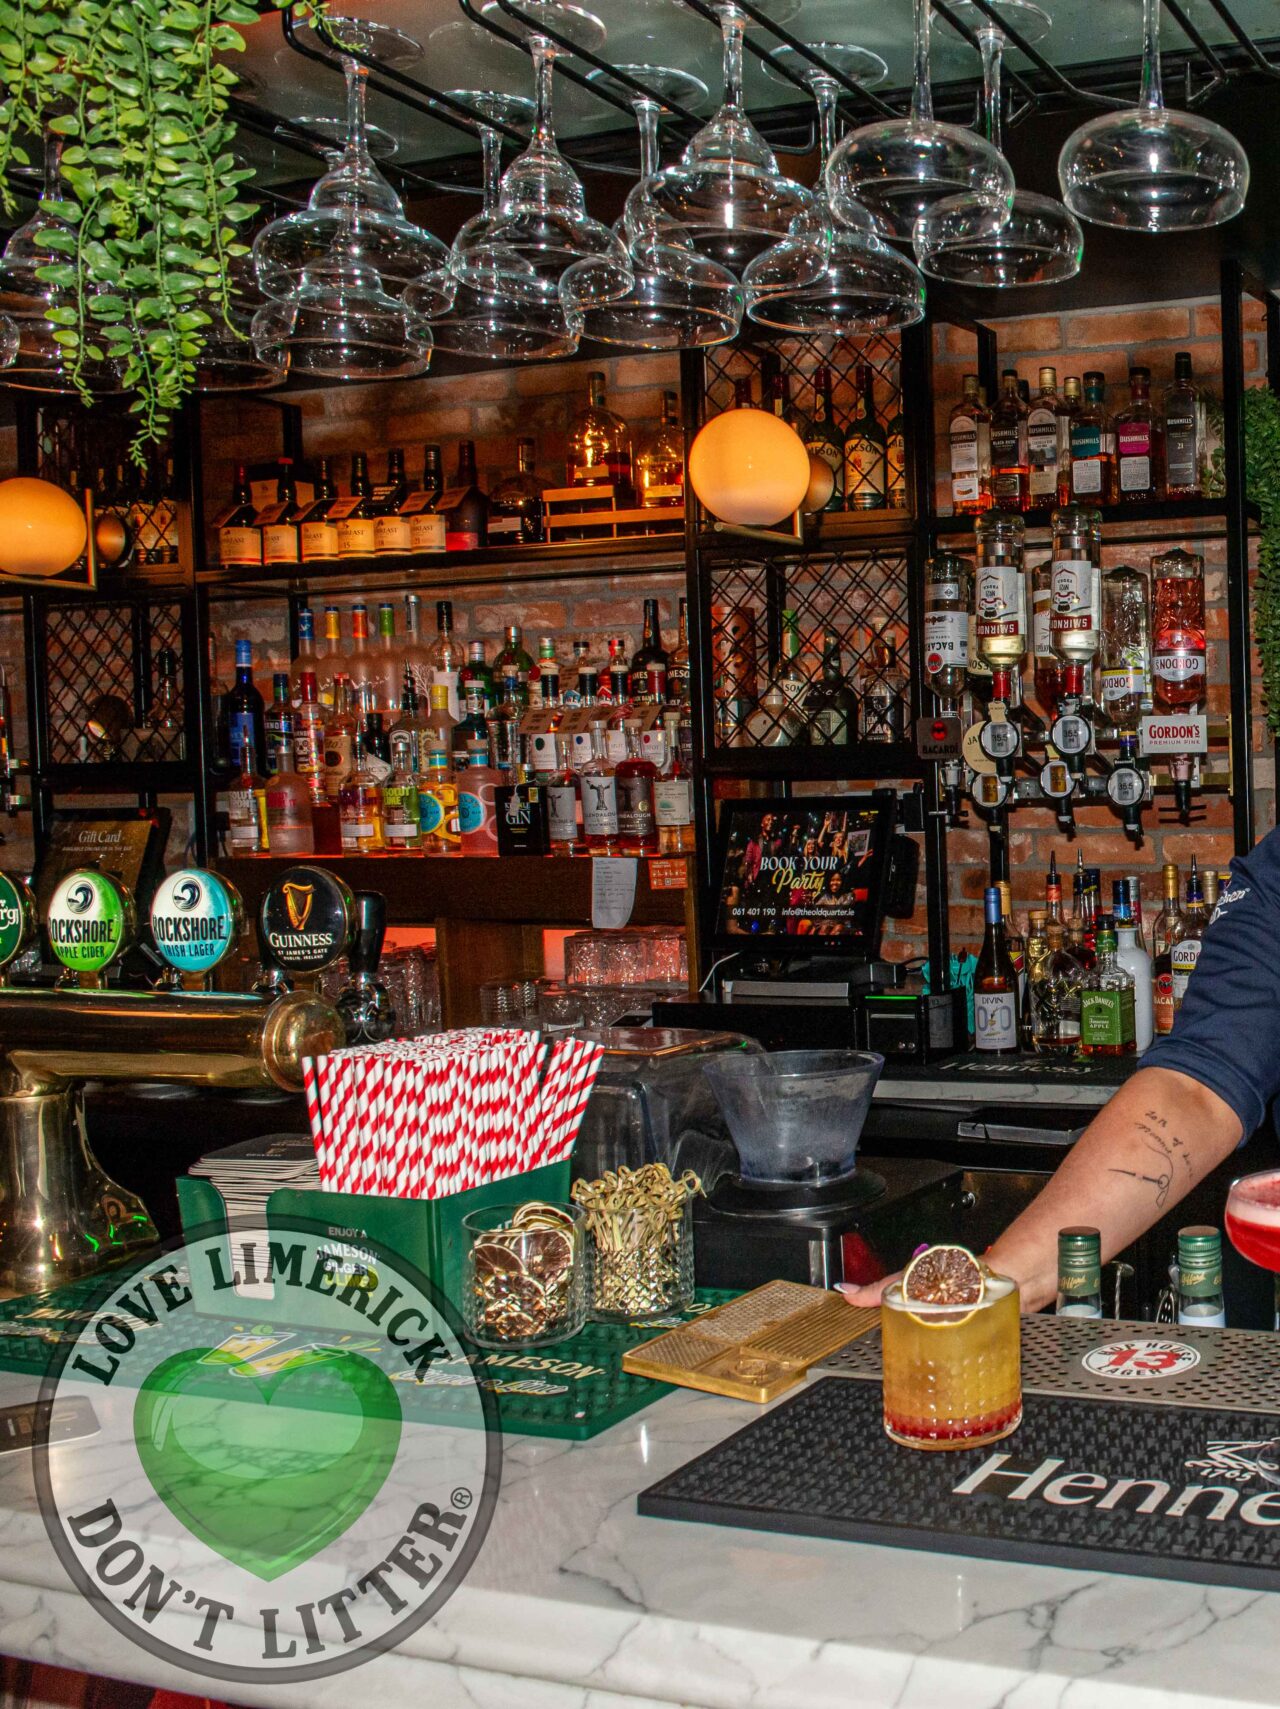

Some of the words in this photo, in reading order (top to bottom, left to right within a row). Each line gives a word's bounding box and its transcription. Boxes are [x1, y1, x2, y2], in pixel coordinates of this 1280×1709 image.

[1149, 724, 1201, 739] GORDON'S
[505, 810, 531, 825] GIN
[78, 830, 97, 843] Gift
[98, 830, 122, 843] Card
[760, 856, 799, 870] BOOK
[802, 856, 839, 871] YOUR
[772, 868, 825, 900] Party
[732, 908, 745, 916] 061
[747, 908, 760, 916] 401
[763, 908, 776, 916] 190
[781, 907, 856, 918] info@theoldquarter.ie
[49, 917, 116, 943] OCKSHORE
[269, 932, 333, 948] GUINNESS
[81, 945, 105, 959] CIDER
[163, 944, 187, 958] IRISH
[188, 944, 215, 956] LAGER
[940, 1062, 1104, 1075] Hennessy
[328, 1226, 358, 1239] ENJOY
[360, 1229, 368, 1239] A
[1107, 1348, 1180, 1371] 13
[1200, 1467, 1254, 1482] 1765
